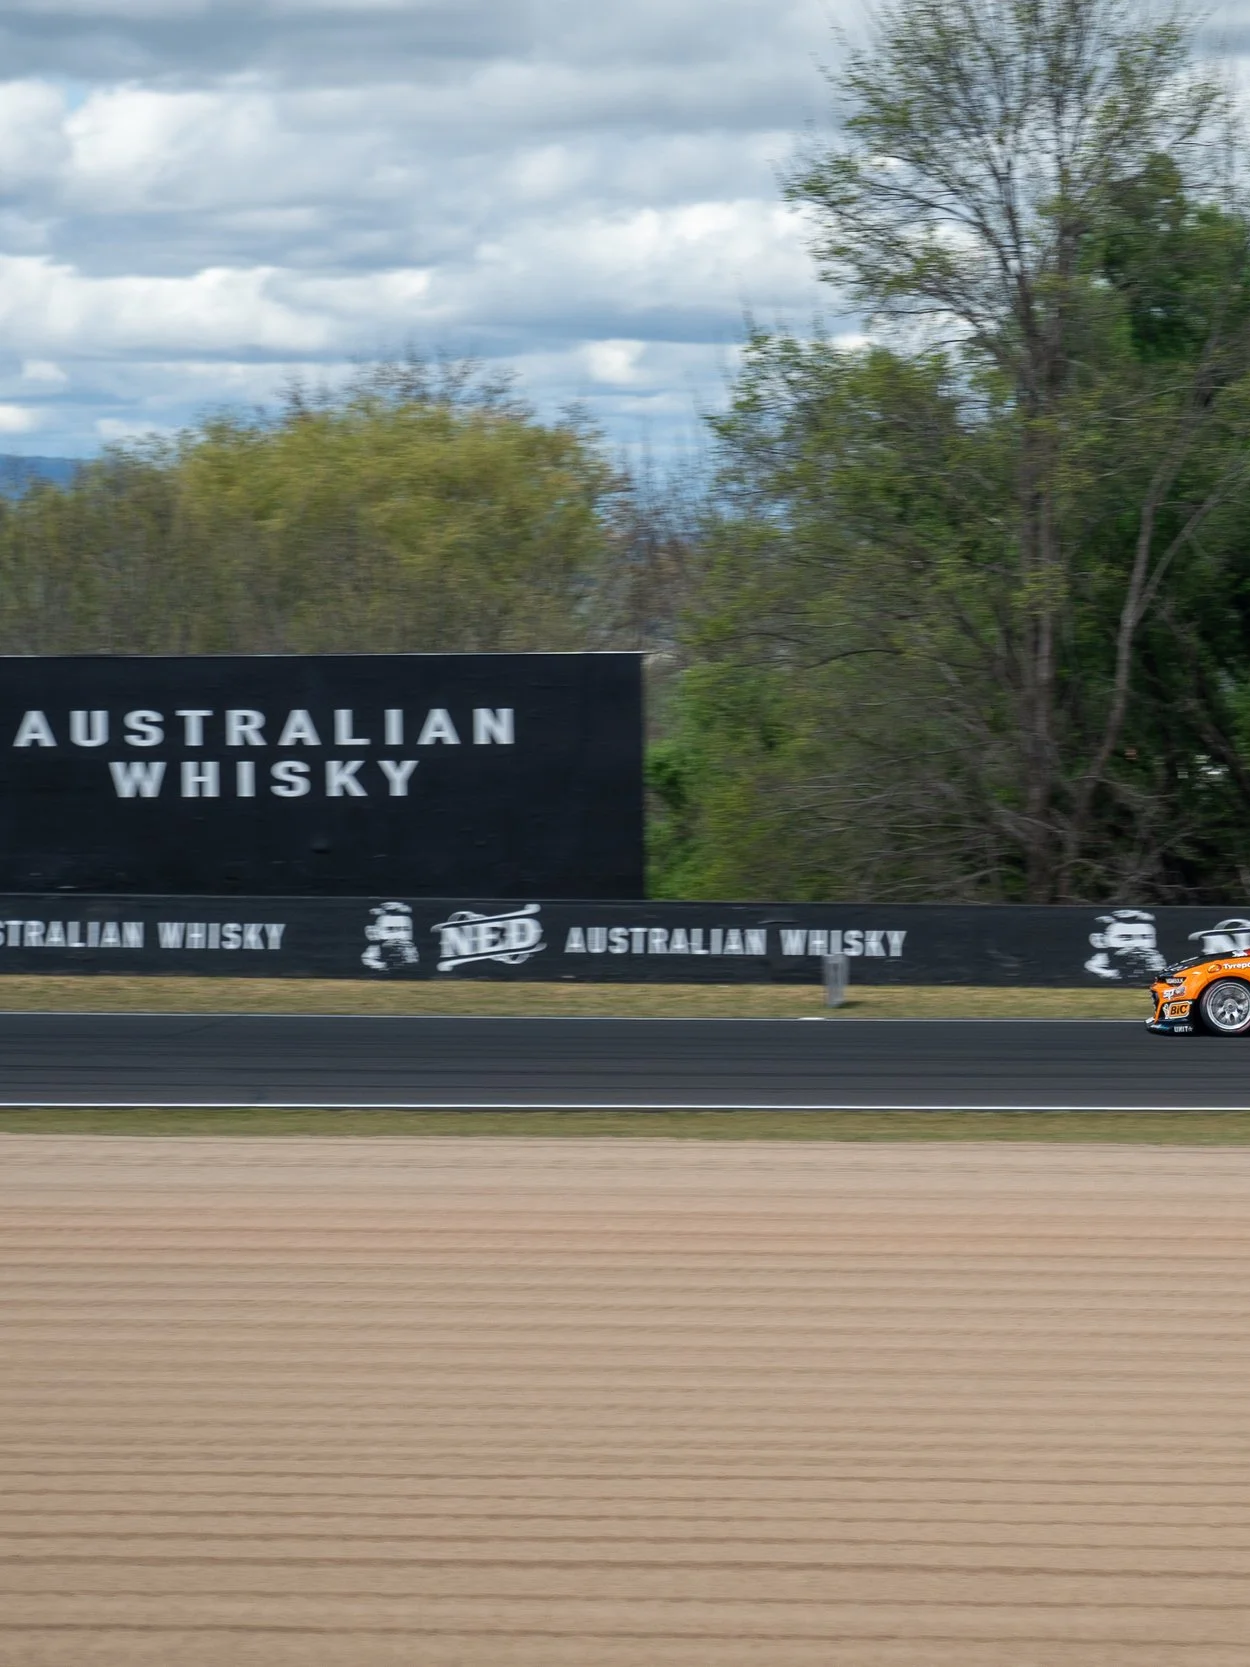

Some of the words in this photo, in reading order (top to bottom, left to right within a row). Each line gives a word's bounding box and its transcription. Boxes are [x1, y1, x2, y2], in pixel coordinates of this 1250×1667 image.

[13, 708, 516, 748] AUSTRALIAN
[109, 760, 419, 798] WHISKY
[0, 920, 144, 948] TRALIAN
[157, 921, 286, 950] WHISKY
[565, 926, 767, 956] AUSTRALIAN
[780, 929, 907, 957] WHISKY
